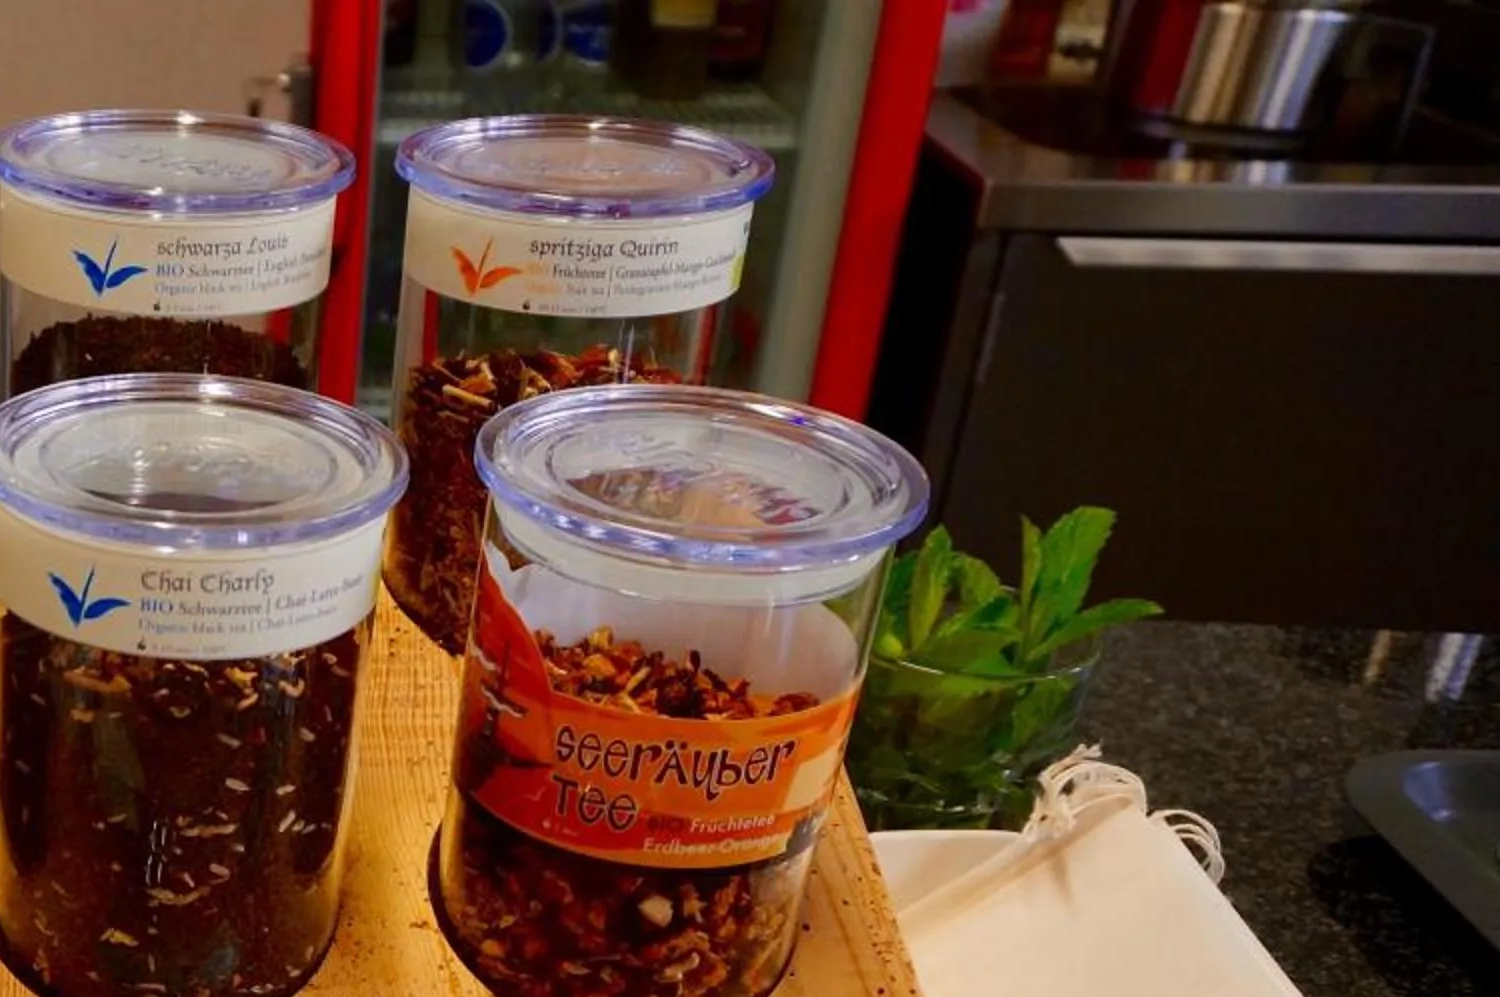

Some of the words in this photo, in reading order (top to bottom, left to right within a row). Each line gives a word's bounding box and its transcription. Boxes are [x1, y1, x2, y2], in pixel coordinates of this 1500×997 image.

[528, 237, 613, 262] spritziga
[619, 238, 680, 258] Quirin
[156, 263, 184, 277] BIO
[140, 569, 193, 594] Chai
[199, 567, 276, 596] Charly
[140, 599, 174, 614] BIO
